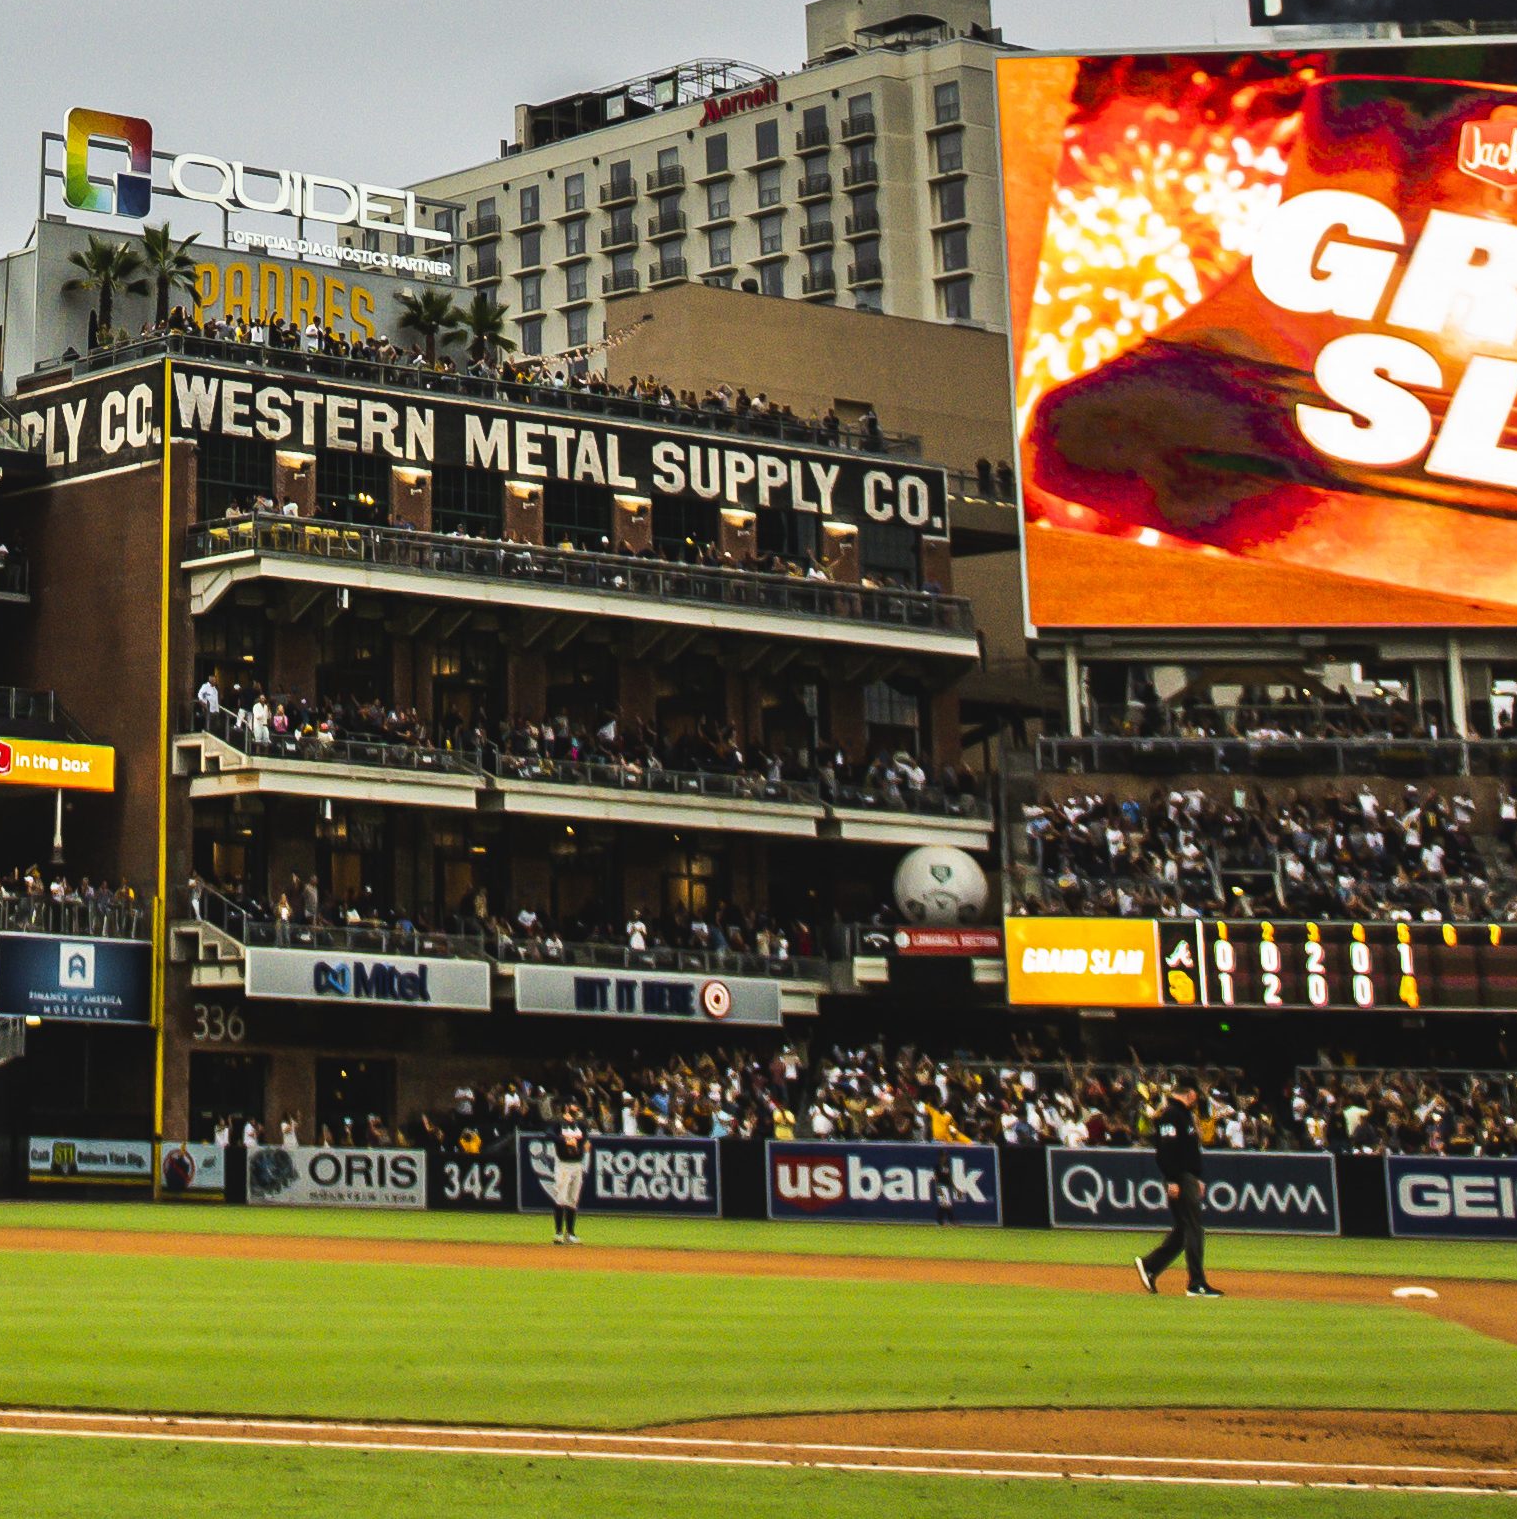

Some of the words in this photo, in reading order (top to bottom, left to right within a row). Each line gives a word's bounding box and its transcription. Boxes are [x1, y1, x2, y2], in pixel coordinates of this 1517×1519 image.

[699, 79, 778, 127] Marriott
[169, 154, 452, 242] QUIDEL
[233, 231, 297, 253] OFFICIAL
[298, 239, 388, 267] DIAGNOSTICS
[391, 254, 452, 277] PARTNER
[194, 262, 375, 346] PADRES
[101, 383, 161, 454] CO.
[173, 373, 434, 461] WESTERN
[465, 414, 637, 490] METAL
[653, 441, 840, 515] SUPPLY
[864, 470, 943, 530] CO.
[15, 754, 30, 767] in
[33, 754, 58, 770] the
[62, 756, 91, 772] box
[1022, 947, 1087, 975] GRAND
[1090, 948, 1144, 976] SLAM
[1214, 940, 1235, 972] 0
[1260, 941, 1280, 972] 0
[1305, 941, 1325, 974] 2
[1350, 942, 1372, 974] 0
[1397, 943, 1413, 975] 1
[1218, 973, 1234, 1006] 1
[1262, 973, 1283, 1006] 2
[1307, 974, 1328, 1008] 0
[1353, 974, 1373, 1008] 0
[193, 1003, 244, 1041] 336
[308, 1153, 418, 1189] ORIS
[444, 1161, 502, 1201] 342
[596, 1149, 706, 1178] ROCKET
[596, 1174, 711, 1201] LEAGUE
[1062, 1165, 1328, 1215] Quaomm
